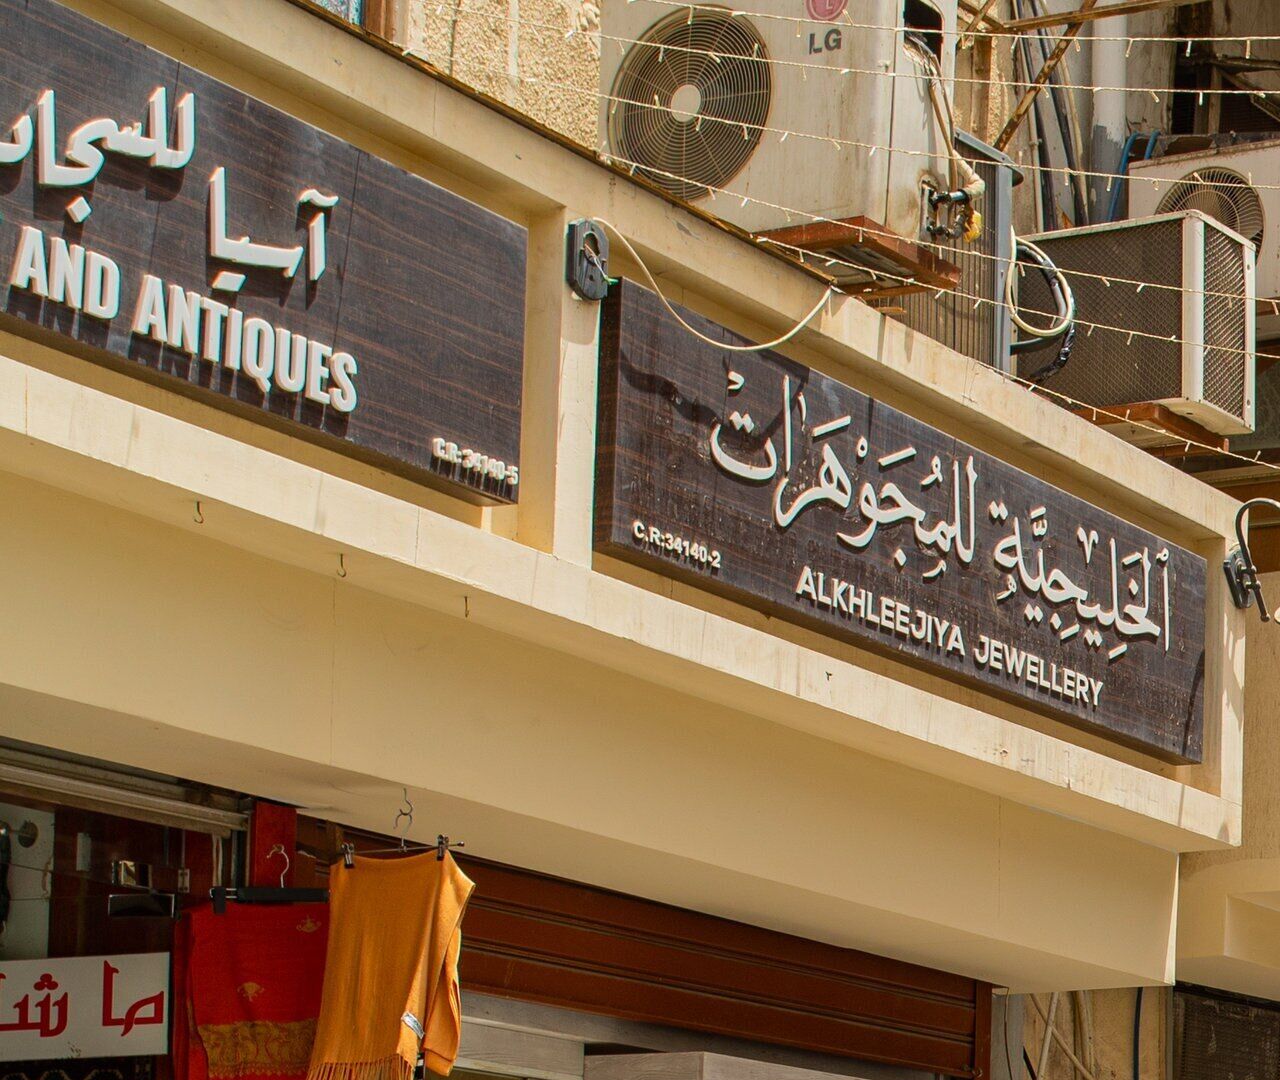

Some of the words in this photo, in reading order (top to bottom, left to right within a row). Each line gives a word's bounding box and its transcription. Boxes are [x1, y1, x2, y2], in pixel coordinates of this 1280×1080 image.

[809, 28, 842, 54] LG
[210, 166, 339, 291] آسيا
[10, 226, 121, 319] AND
[132, 275, 358, 412] ANTIQUES
[796, 566, 966, 656] ALKHLEEJIYA
[974, 635, 1104, 707] JEWELLERY
[102, 960, 164, 1037] ما
